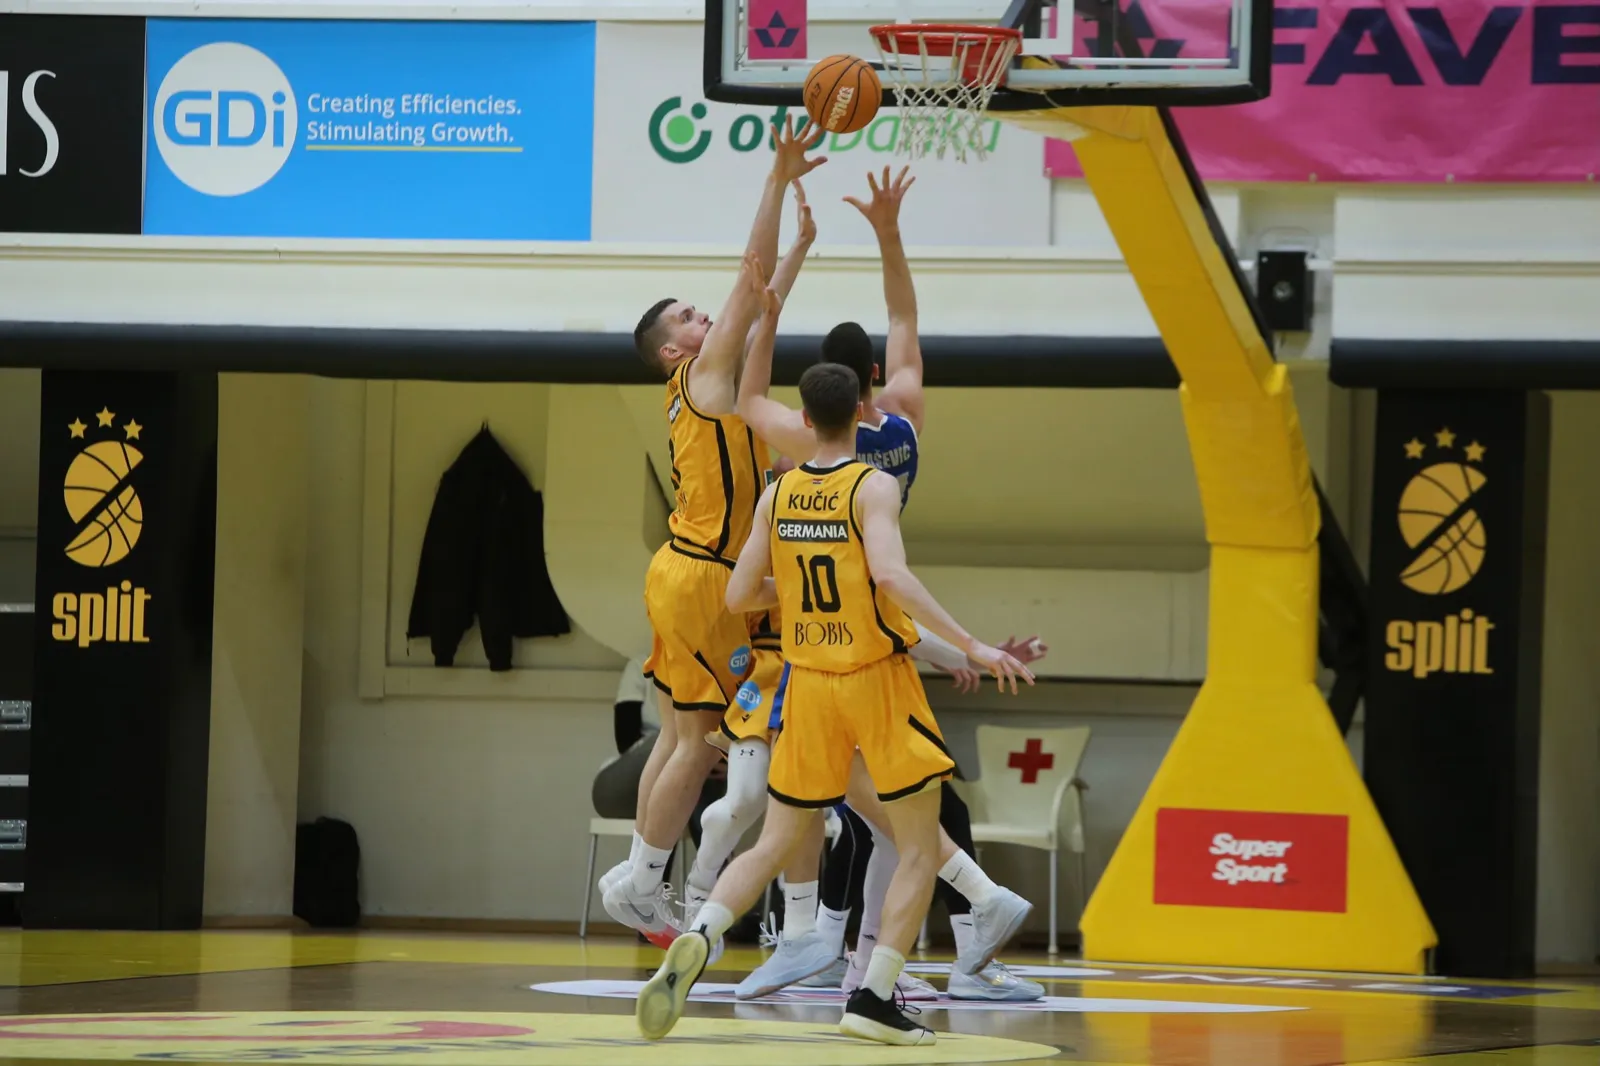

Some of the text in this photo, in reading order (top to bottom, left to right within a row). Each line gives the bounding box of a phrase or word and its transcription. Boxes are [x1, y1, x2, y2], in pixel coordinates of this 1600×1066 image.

[163, 90, 286, 148] GDi
[307, 93, 522, 119] Creating Efficiencies.
[306, 121, 426, 146] Stimulating
[788, 490, 839, 511] KUČIĆ
[777, 523, 848, 539] GERMANIA
[796, 554, 842, 613] 10
[51, 580, 151, 647] split
[795, 621, 854, 647] BOBIS
[1385, 608, 1495, 679] split
[1208, 832, 1292, 860] Super
[1212, 858, 1288, 885] Sport
